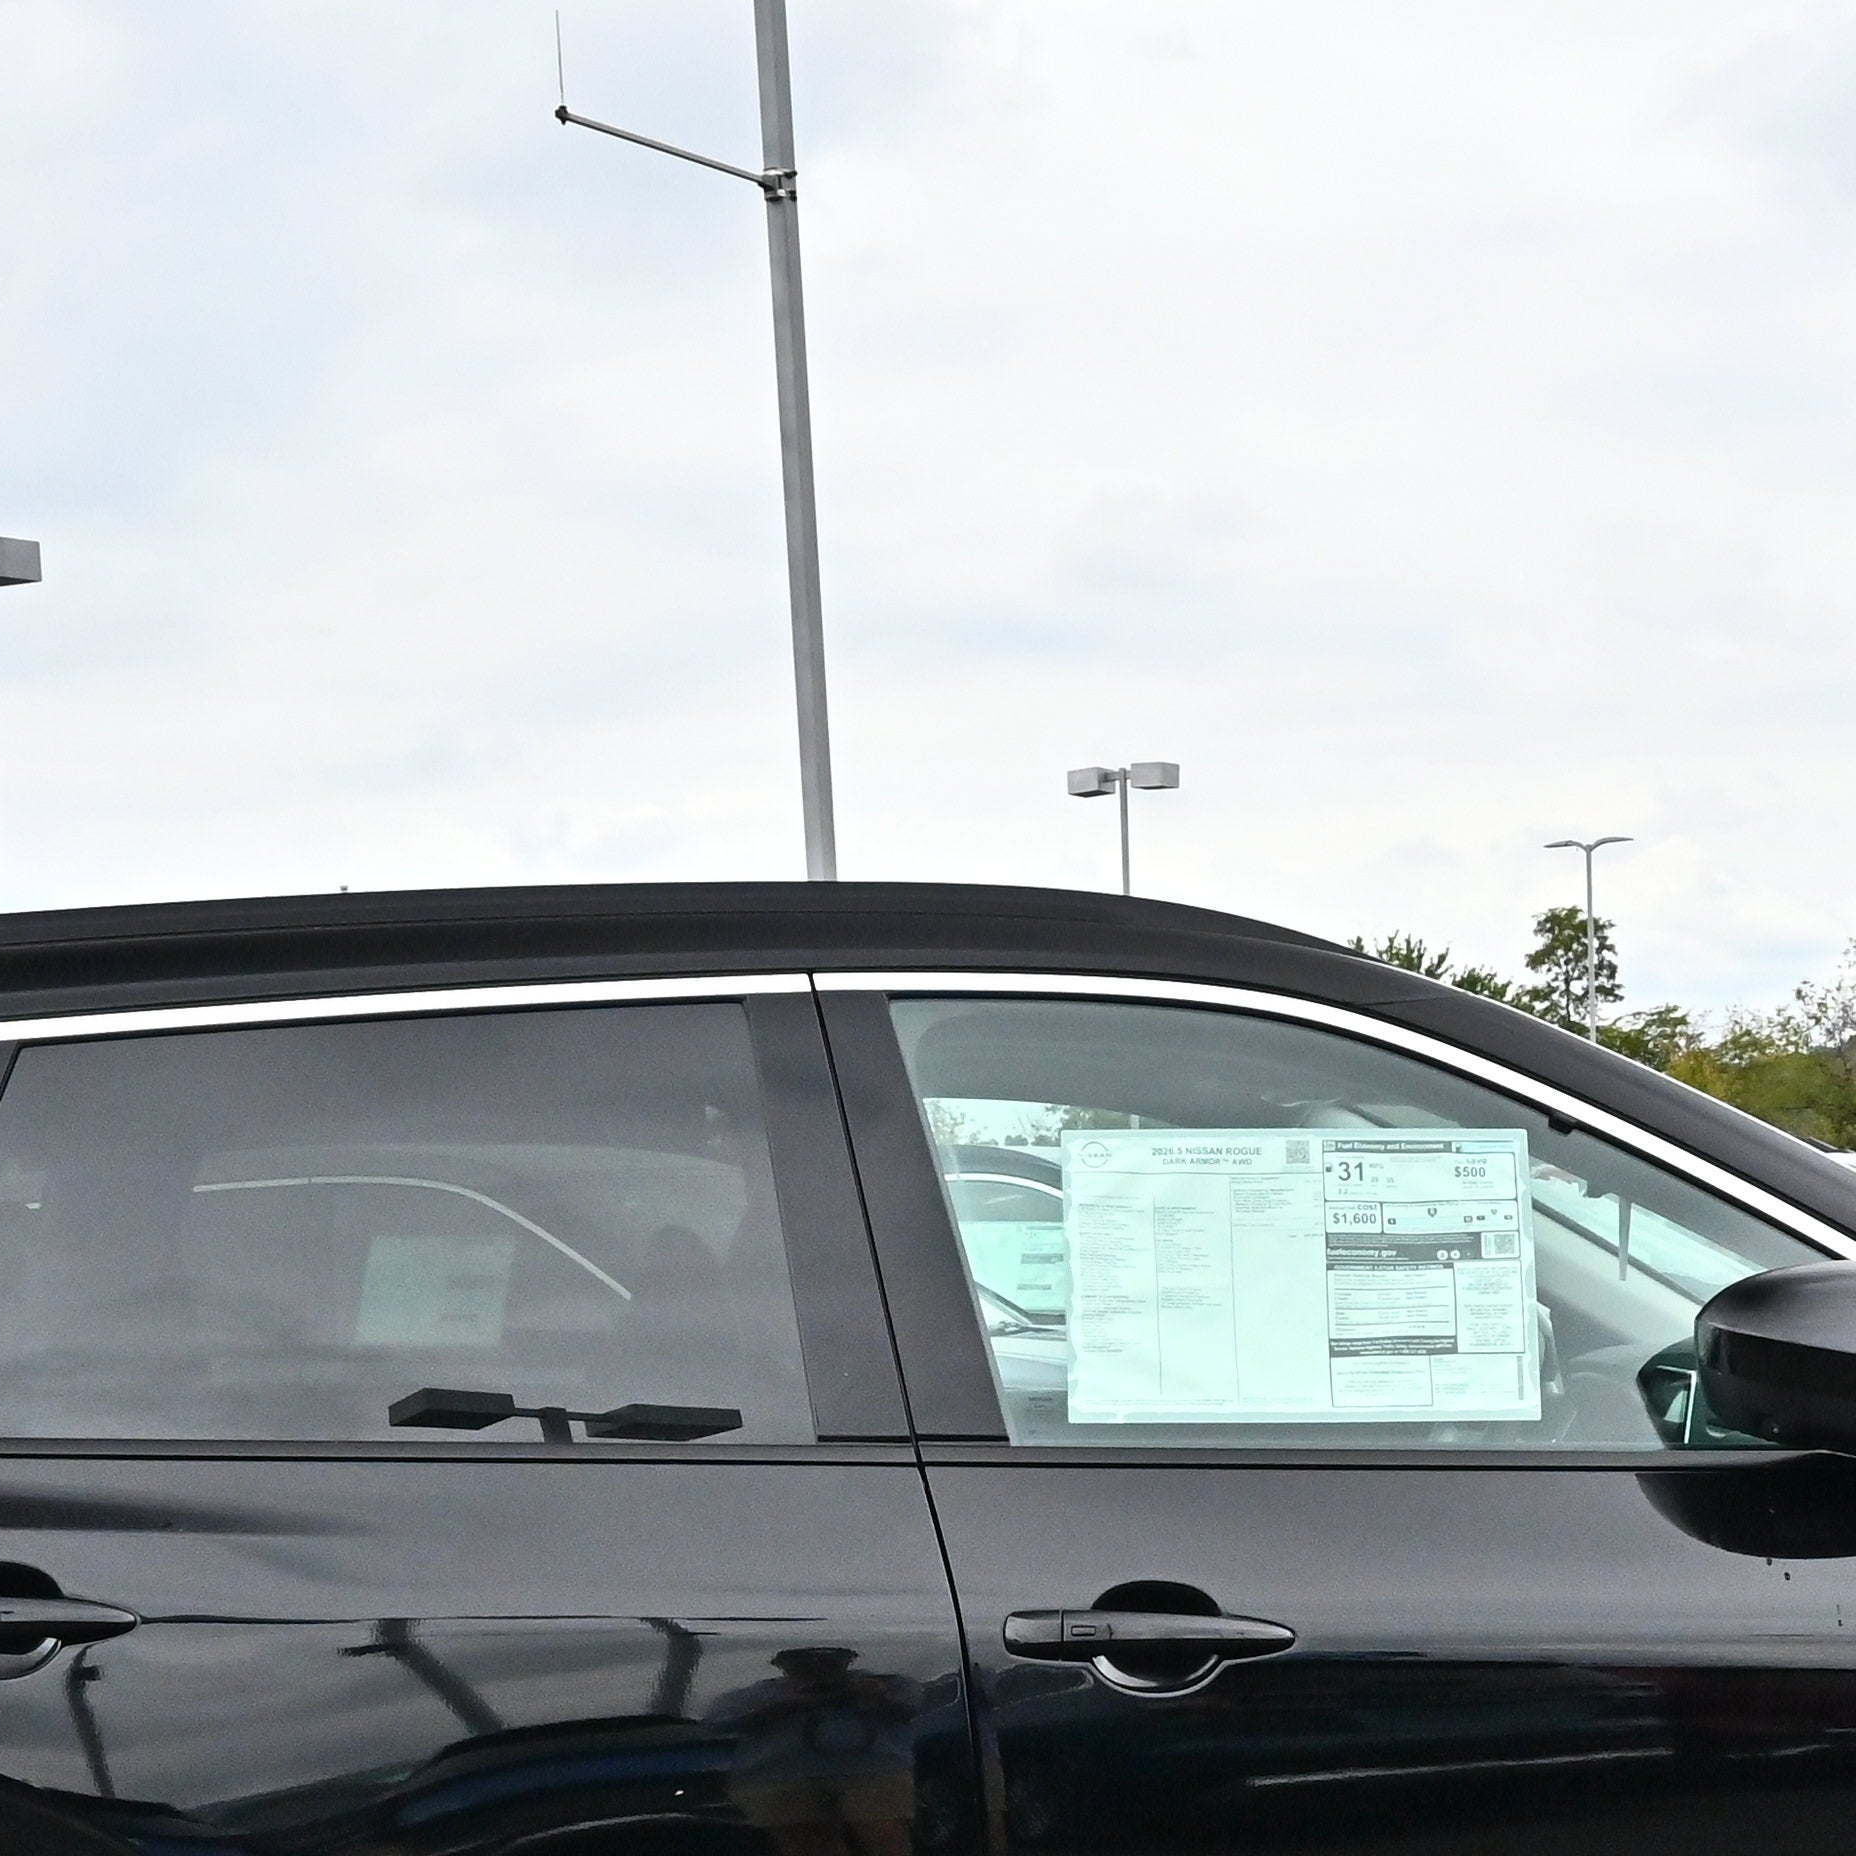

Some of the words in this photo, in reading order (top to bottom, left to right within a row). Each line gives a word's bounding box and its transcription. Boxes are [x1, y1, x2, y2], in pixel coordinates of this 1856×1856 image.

[1151, 1146, 1183, 1156] 2026.5
[1185, 1146, 1223, 1155] NISSAN
[1225, 1146, 1263, 1156] ROGUE
[1162, 1157, 1187, 1165] DARK
[1231, 1157, 1253, 1165] AWD
[1337, 1160, 1364, 1182] 31
[1454, 1165, 1486, 1178] $500
[1332, 1212, 1377, 1226] $1,600
